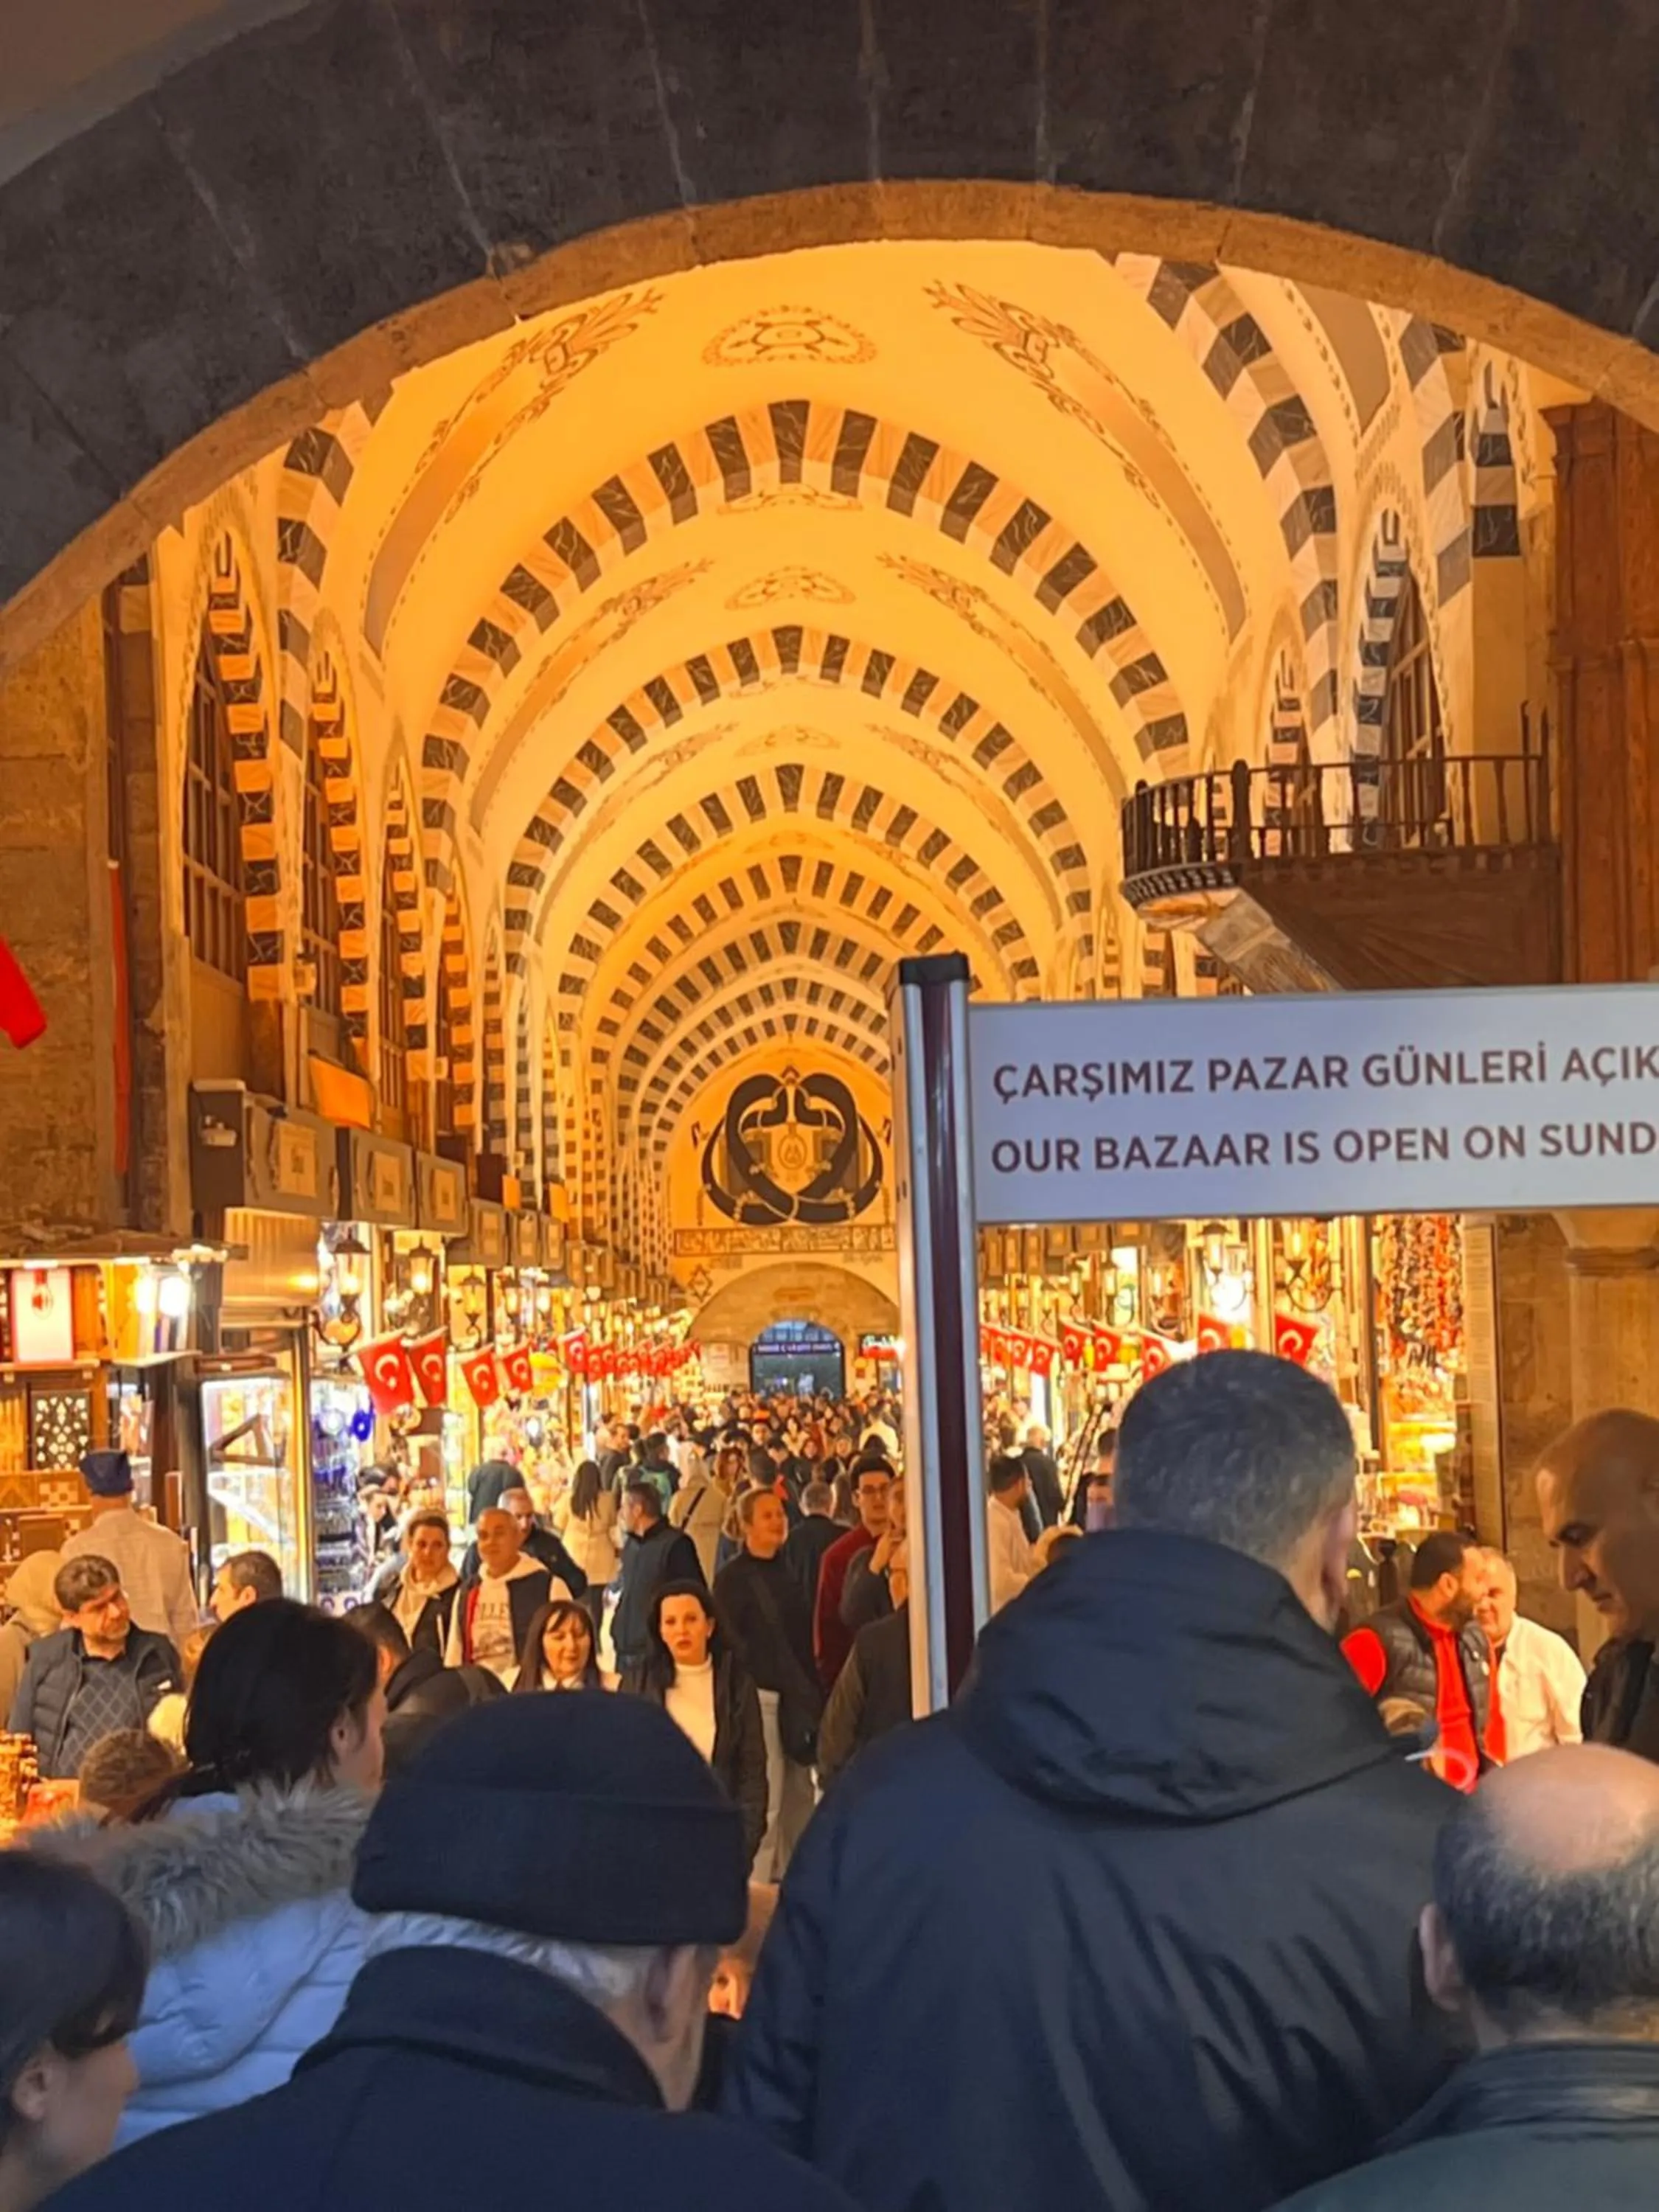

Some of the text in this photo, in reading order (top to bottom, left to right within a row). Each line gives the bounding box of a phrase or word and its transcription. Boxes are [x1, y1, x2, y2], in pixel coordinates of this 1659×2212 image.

[992, 1040, 1659, 1105] ÇARŞIMIZ PAZAR GÜNLERİ AÇIK
[991, 1121, 1658, 1174] OUR BAZAAR IS OPEN ON SUND
